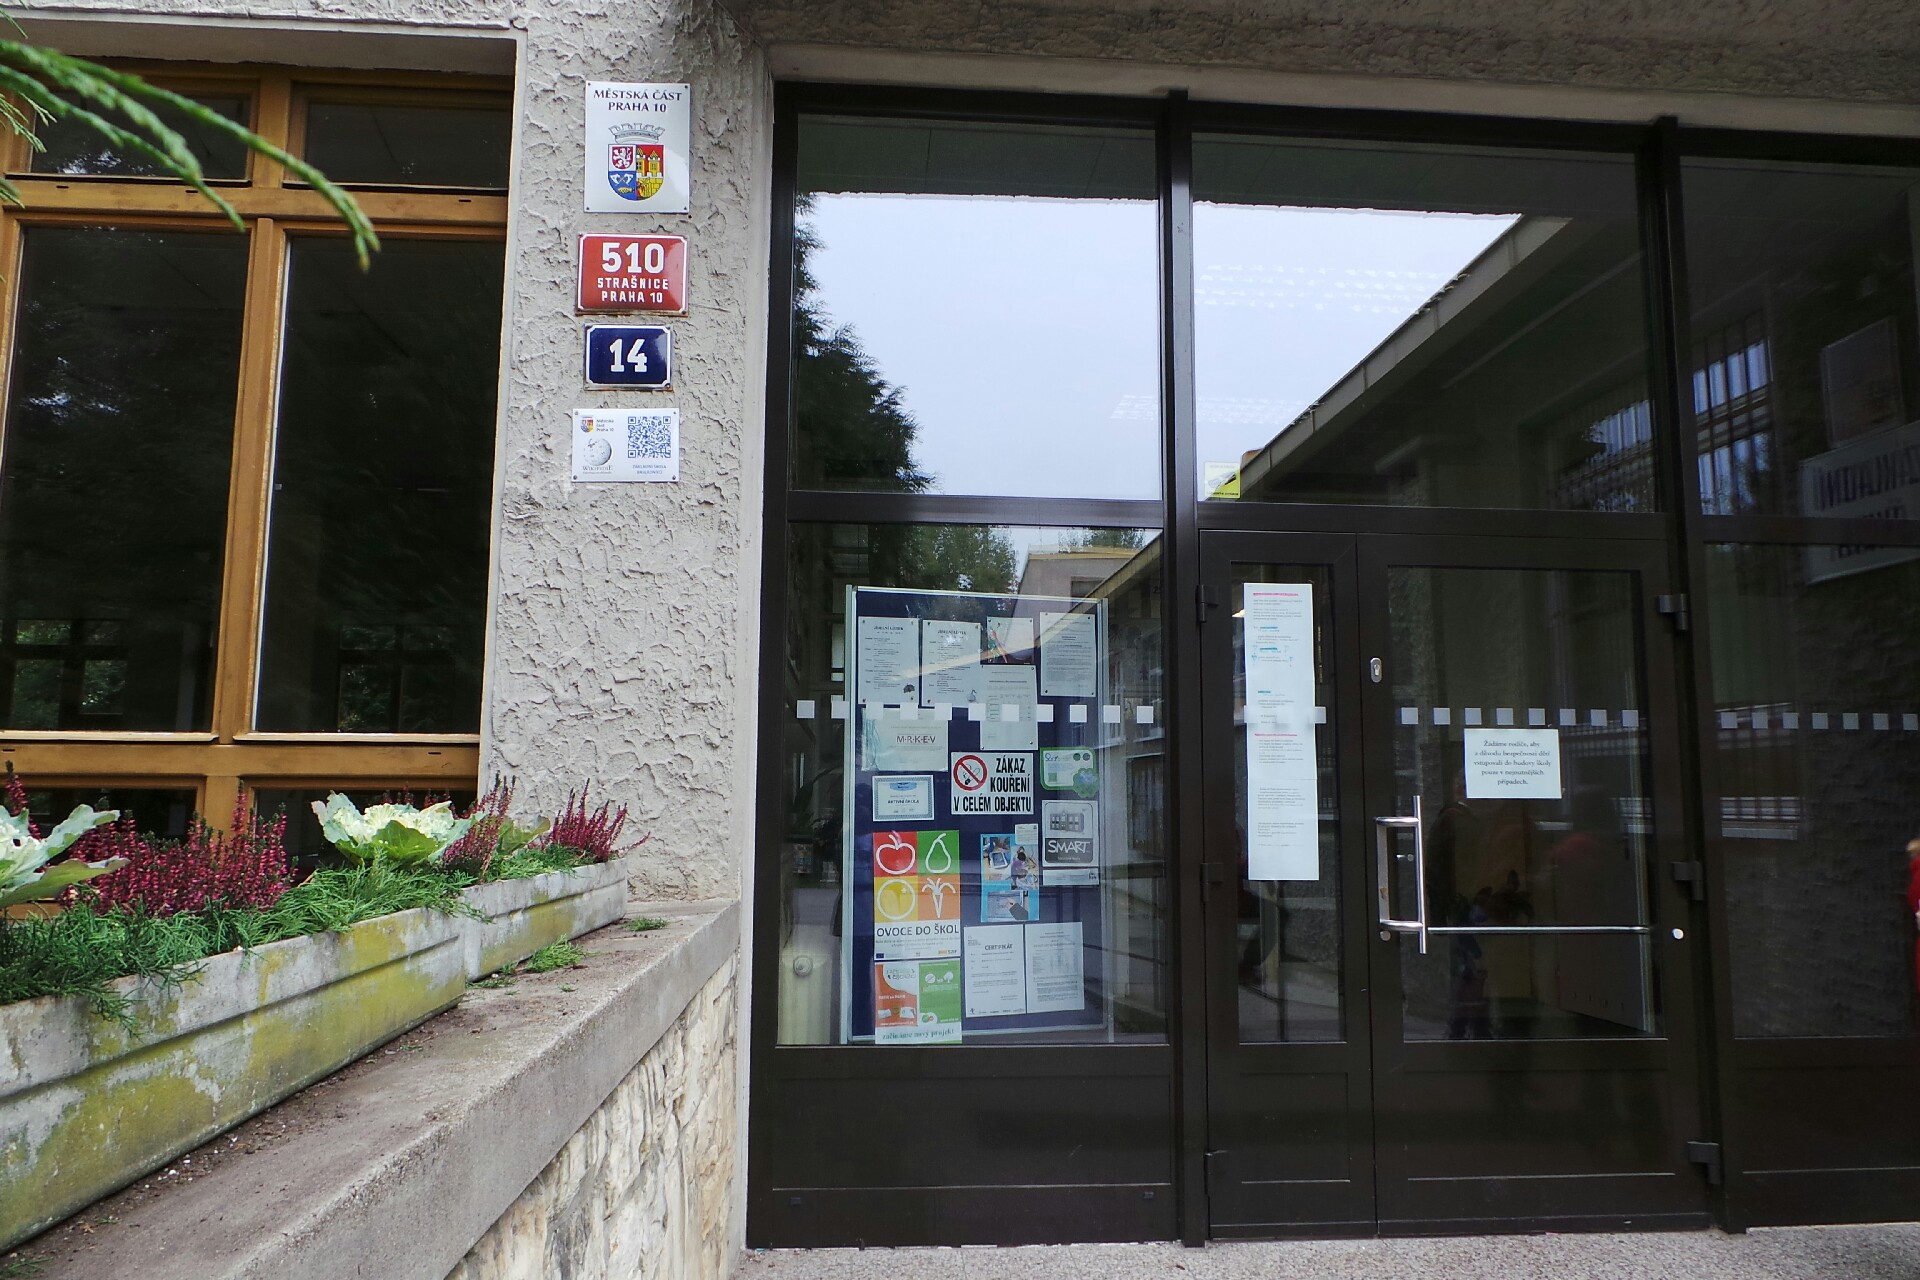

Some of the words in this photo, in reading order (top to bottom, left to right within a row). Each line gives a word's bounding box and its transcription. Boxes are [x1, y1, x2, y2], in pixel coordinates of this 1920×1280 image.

[593, 88, 649, 100] MĚSTSKÁ
[652, 89, 682, 101] ČÁST
[608, 102, 649, 112] PRAHA
[654, 103, 667, 113] 10
[601, 242, 665, 274] 510
[597, 275, 669, 290] STRAŠNICE
[602, 290, 645, 303] PRAHA
[650, 292, 663, 303] 10
[609, 338, 648, 373] 14
[995, 755, 1025, 774] ZÁKAZ
[990, 774, 1031, 792] KOUŘENÍ
[954, 797, 960, 812] V
[962, 793, 991, 812] CELÉM
[994, 797, 1032, 812] OBJEKTU
[1047, 840, 1090, 854] SMART
[876, 927, 913, 937] OVOCE
[915, 926, 931, 935] DO
[934, 923, 960, 935] ŠKOL
[984, 942, 1013, 951] CERTIFIKÁT
[931, 1028, 954, 1038] projekt
